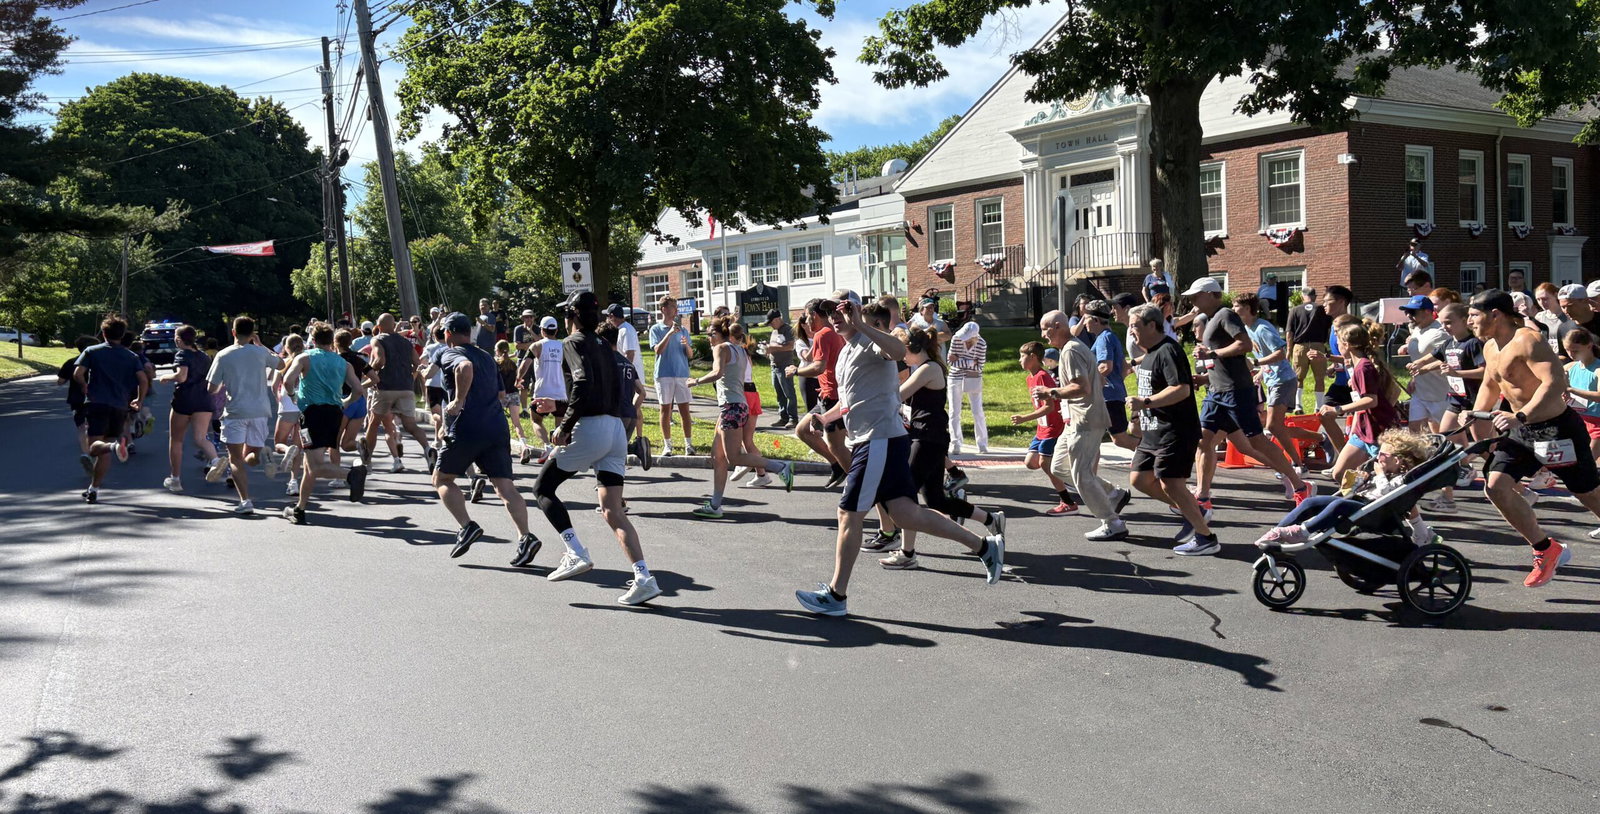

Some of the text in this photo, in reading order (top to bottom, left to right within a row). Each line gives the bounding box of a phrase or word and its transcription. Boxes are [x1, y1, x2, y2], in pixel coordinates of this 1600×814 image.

[1056, 134, 1108, 150] TOWN HALL
[744, 301, 777, 312] TOWN HALL
[622, 367, 632, 380] 15
[1546, 451, 1564, 462] 27
